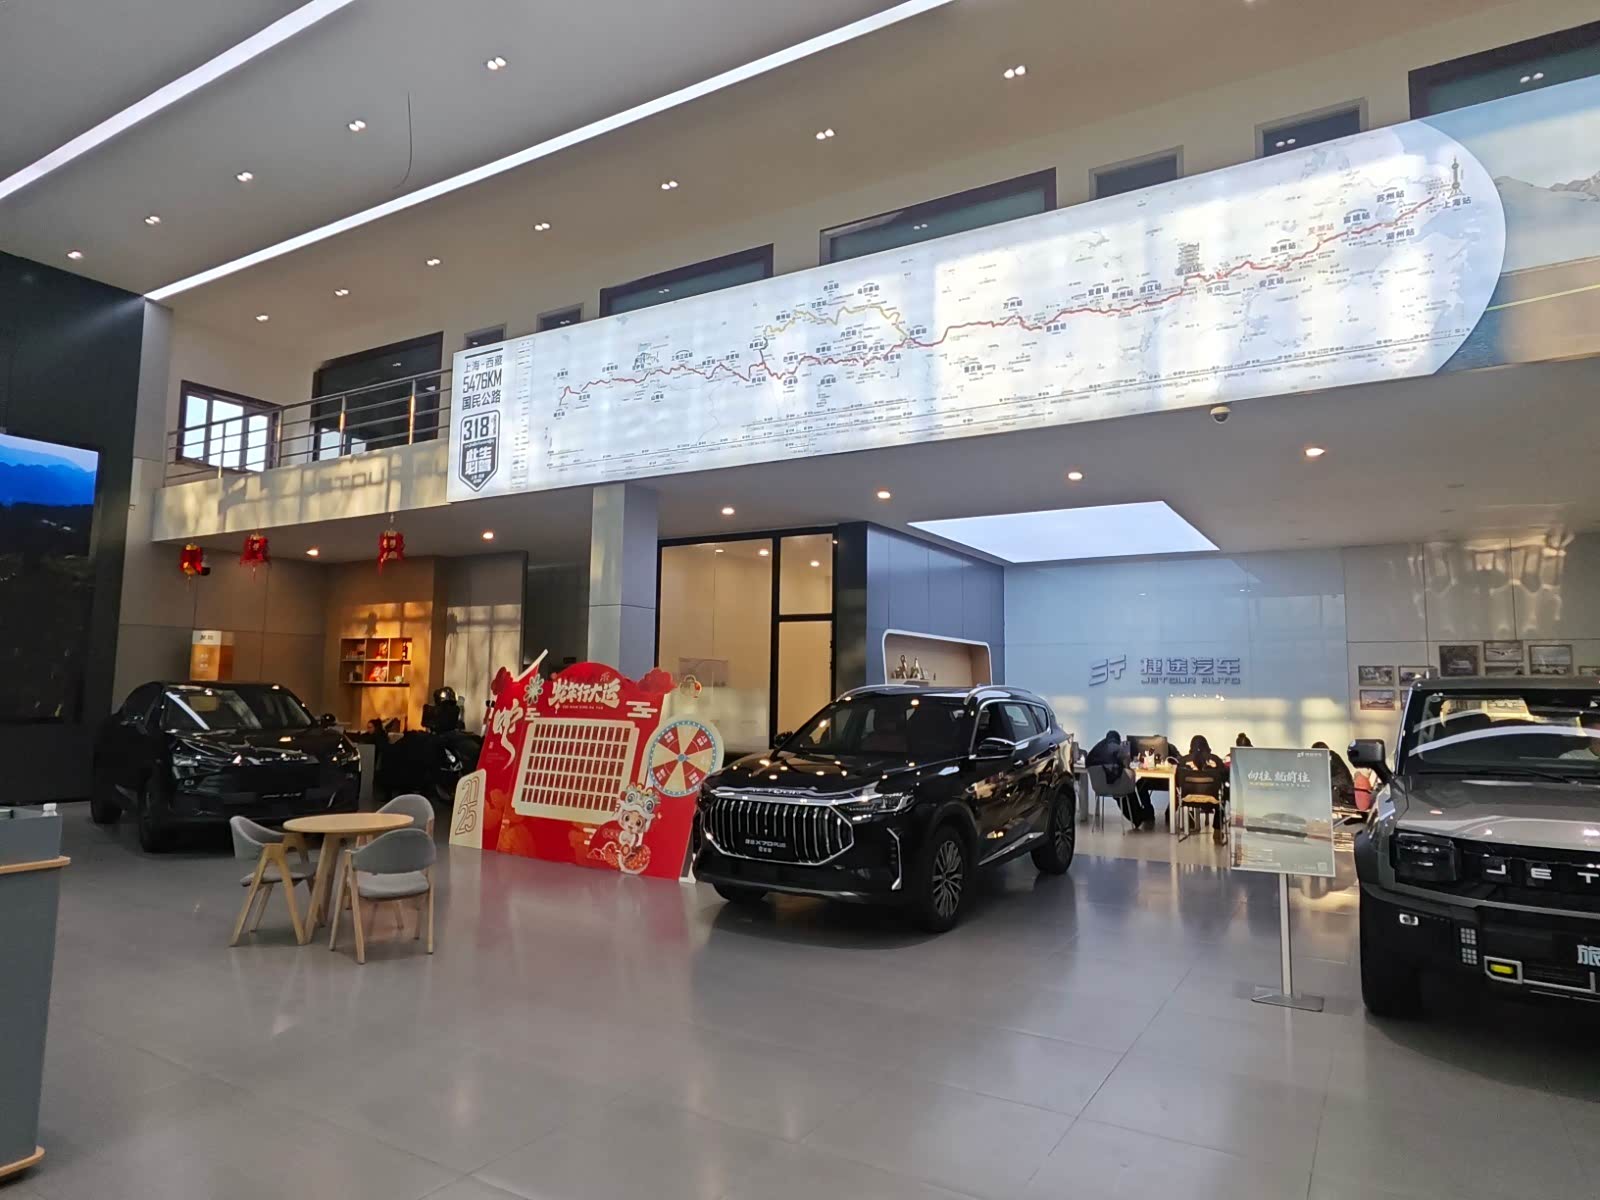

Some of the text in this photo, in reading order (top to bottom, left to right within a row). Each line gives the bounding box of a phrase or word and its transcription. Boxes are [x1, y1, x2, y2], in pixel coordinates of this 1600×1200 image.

[464, 354, 503, 373] 上海-西藏
[462, 368, 502, 394] 5476KM
[462, 389, 501, 411] 国民公路
[463, 416, 490, 441] 318
[1140, 658, 1241, 676] 捷途汽车
[1141, 677, 1241, 685] JETOUR AUTO
[547, 677, 621, 709] 蛇年行大运
